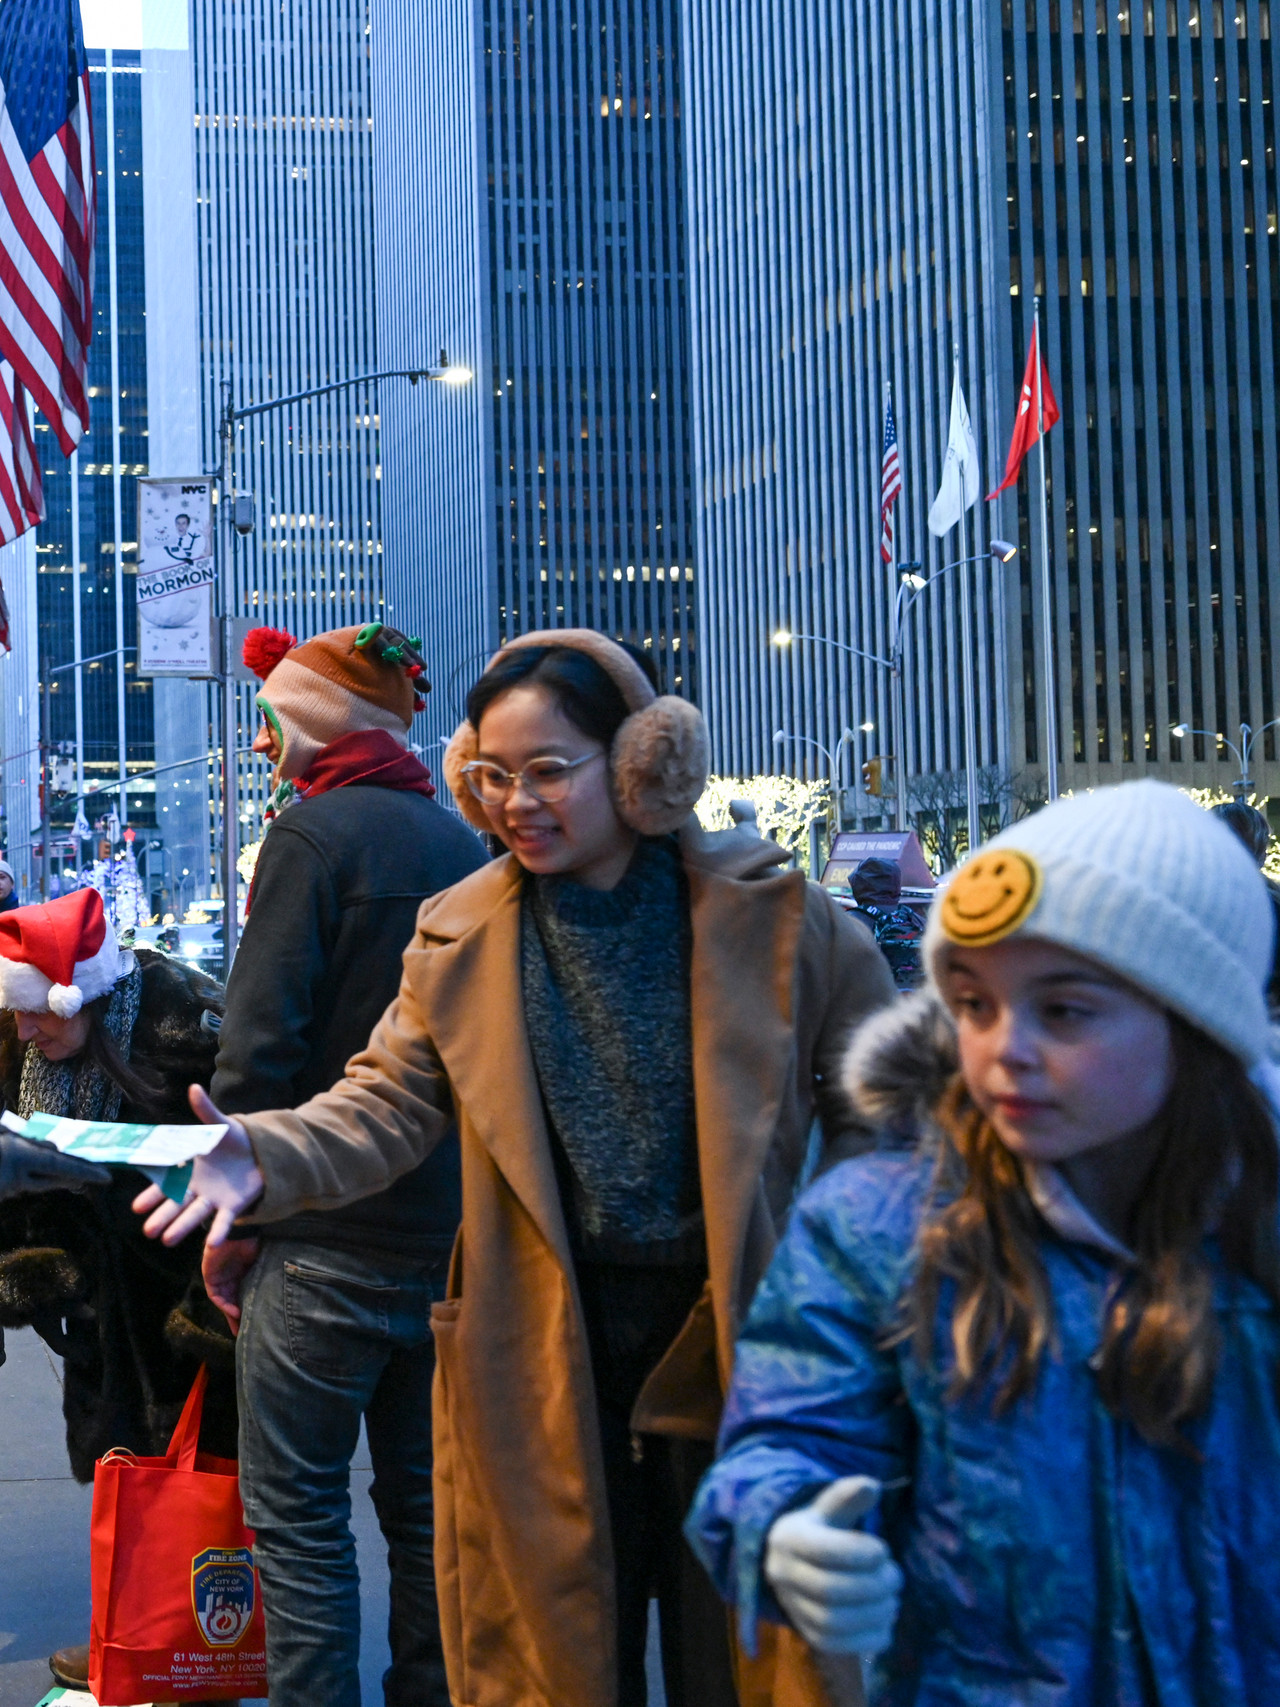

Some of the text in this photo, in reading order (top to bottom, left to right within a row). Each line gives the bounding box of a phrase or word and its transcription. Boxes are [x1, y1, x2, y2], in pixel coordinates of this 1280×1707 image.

[181, 485, 207, 495] NYC
[137, 573, 159, 587] THE
[161, 564, 193, 580] BOOK
[138, 567, 214, 600] MORMON
[866, 841, 877, 851] THE
[209, 1554, 247, 1562] FIRE ZONE
[200, 1573, 214, 1588] FIRE
[173, 1651, 265, 1662] 61 West 48th Street
[170, 1665, 192, 1673] New
[220, 1664, 235, 1672] NY
[238, 1663, 266, 1672] 10020
